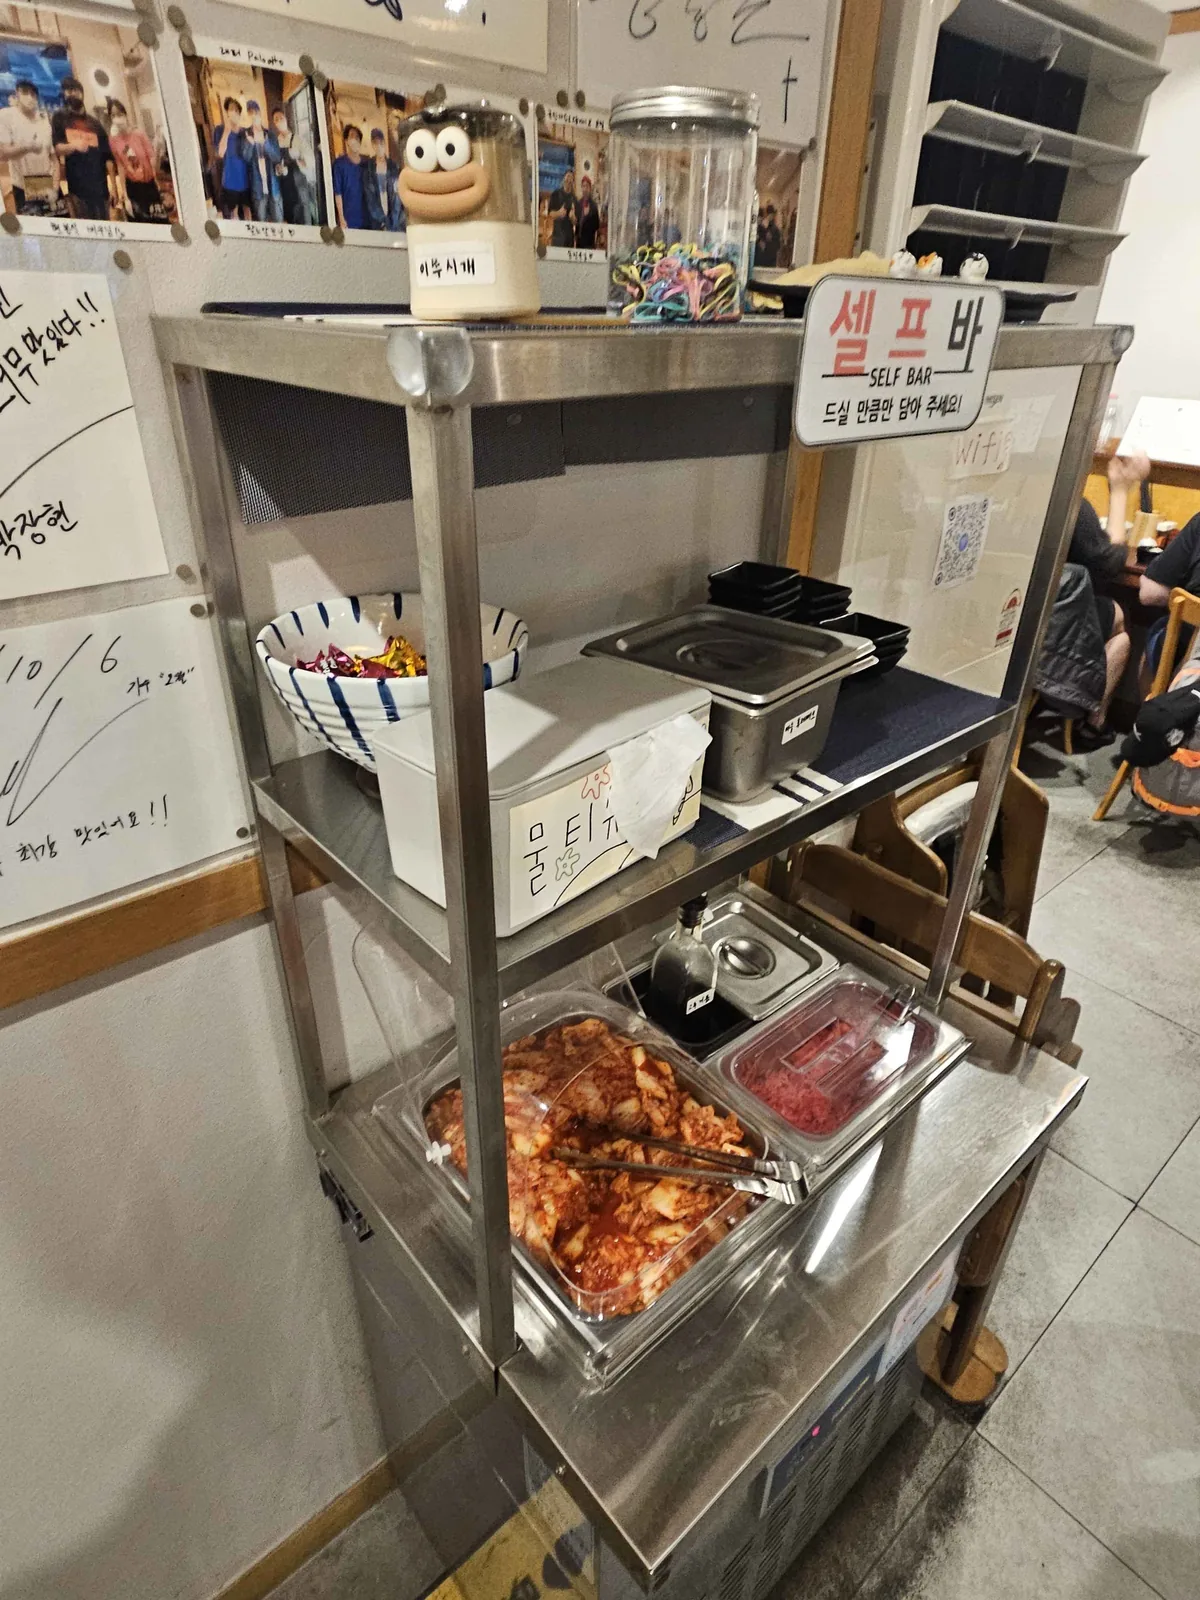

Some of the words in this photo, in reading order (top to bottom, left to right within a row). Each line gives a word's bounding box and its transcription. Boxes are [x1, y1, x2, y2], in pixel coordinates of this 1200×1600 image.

[868, 366, 902, 388] SELF
[906, 366, 933, 386] BAR
[823, 399, 850, 426] 드실
[857, 396, 894, 424] 만큼만
[899, 394, 922, 421] 담아
[926, 393, 963, 418] 주세요!
